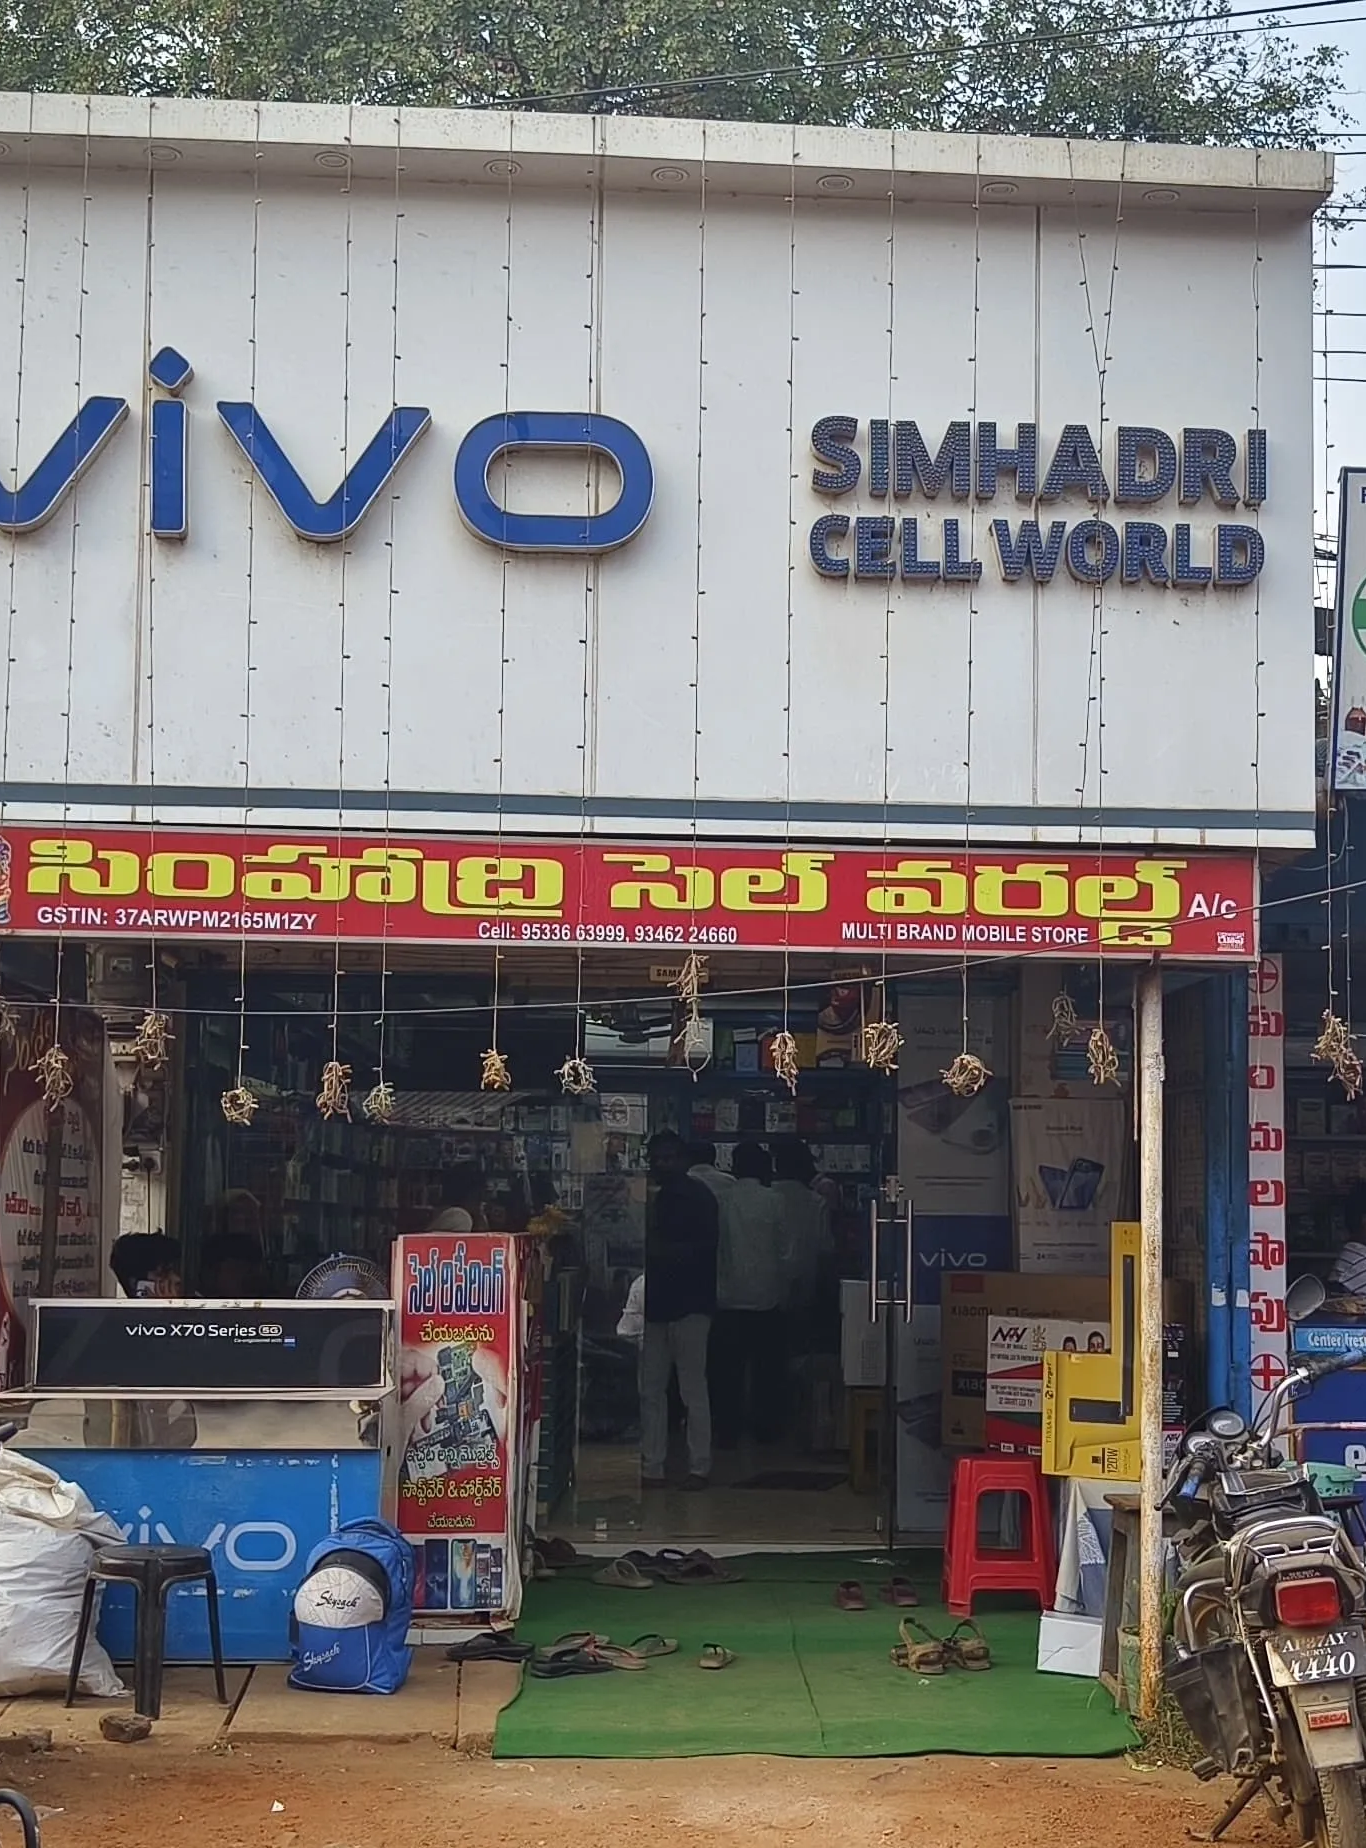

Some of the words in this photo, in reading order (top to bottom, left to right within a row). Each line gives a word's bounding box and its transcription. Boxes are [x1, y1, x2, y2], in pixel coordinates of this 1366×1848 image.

[810, 415, 1268, 507] SIMHADRI
[810, 513, 983, 583] CELL
[992, 518, 1267, 590] WORLD
[25, 838, 567, 918] సింహాద్రి
[602, 850, 835, 913] సెల్
[865, 860, 1189, 949] వరల్డ్
[1187, 892, 1238, 920] A/c
[36, 906, 109, 928] GSTIN:
[114, 908, 318, 932] 37ARWPM2165M1ZY
[478, 921, 515, 940] Cell:
[520, 923, 571, 942] 95336
[576, 925, 630, 945] 63999,
[634, 926, 684, 943] 93462
[688, 926, 738, 945] 24660
[841, 921, 893, 941] MULTI
[897, 923, 958, 942] BRAND
[962, 924, 1026, 943] MOBILE
[1031, 925, 1089, 945] STORE
[918, 1247, 989, 1268] vivo
[125, 1323, 167, 1336] vivo
[170, 1324, 206, 1337] X70
[208, 1324, 257, 1337] Series
[1307, 1331, 1342, 1347] Center
